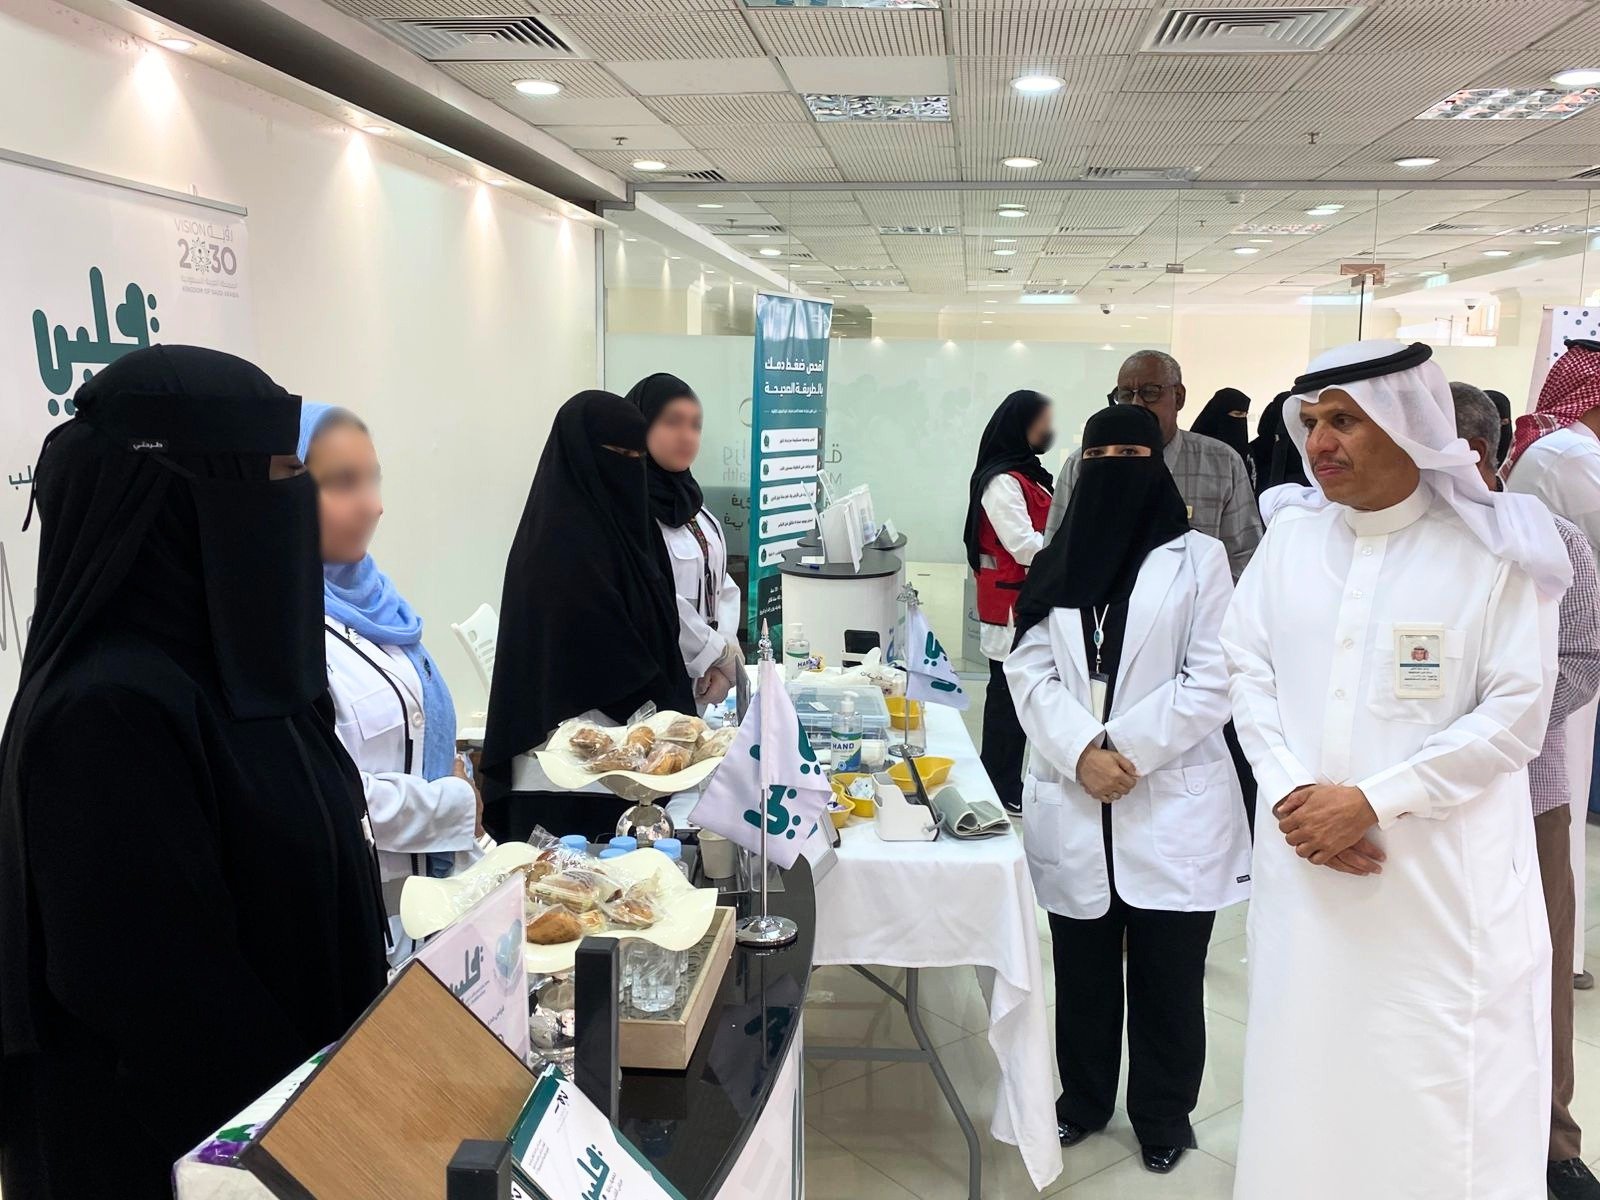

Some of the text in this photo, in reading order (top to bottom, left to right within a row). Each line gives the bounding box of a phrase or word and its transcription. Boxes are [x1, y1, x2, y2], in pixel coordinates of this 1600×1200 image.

[175, 218, 206, 236] VISION
[177, 238, 237, 275] 2030
[764, 356, 824, 375] افحص ضغط دمك
[764, 381, 824, 397] بالطريقة الصحيحة
[832, 742, 855, 750] HAND
